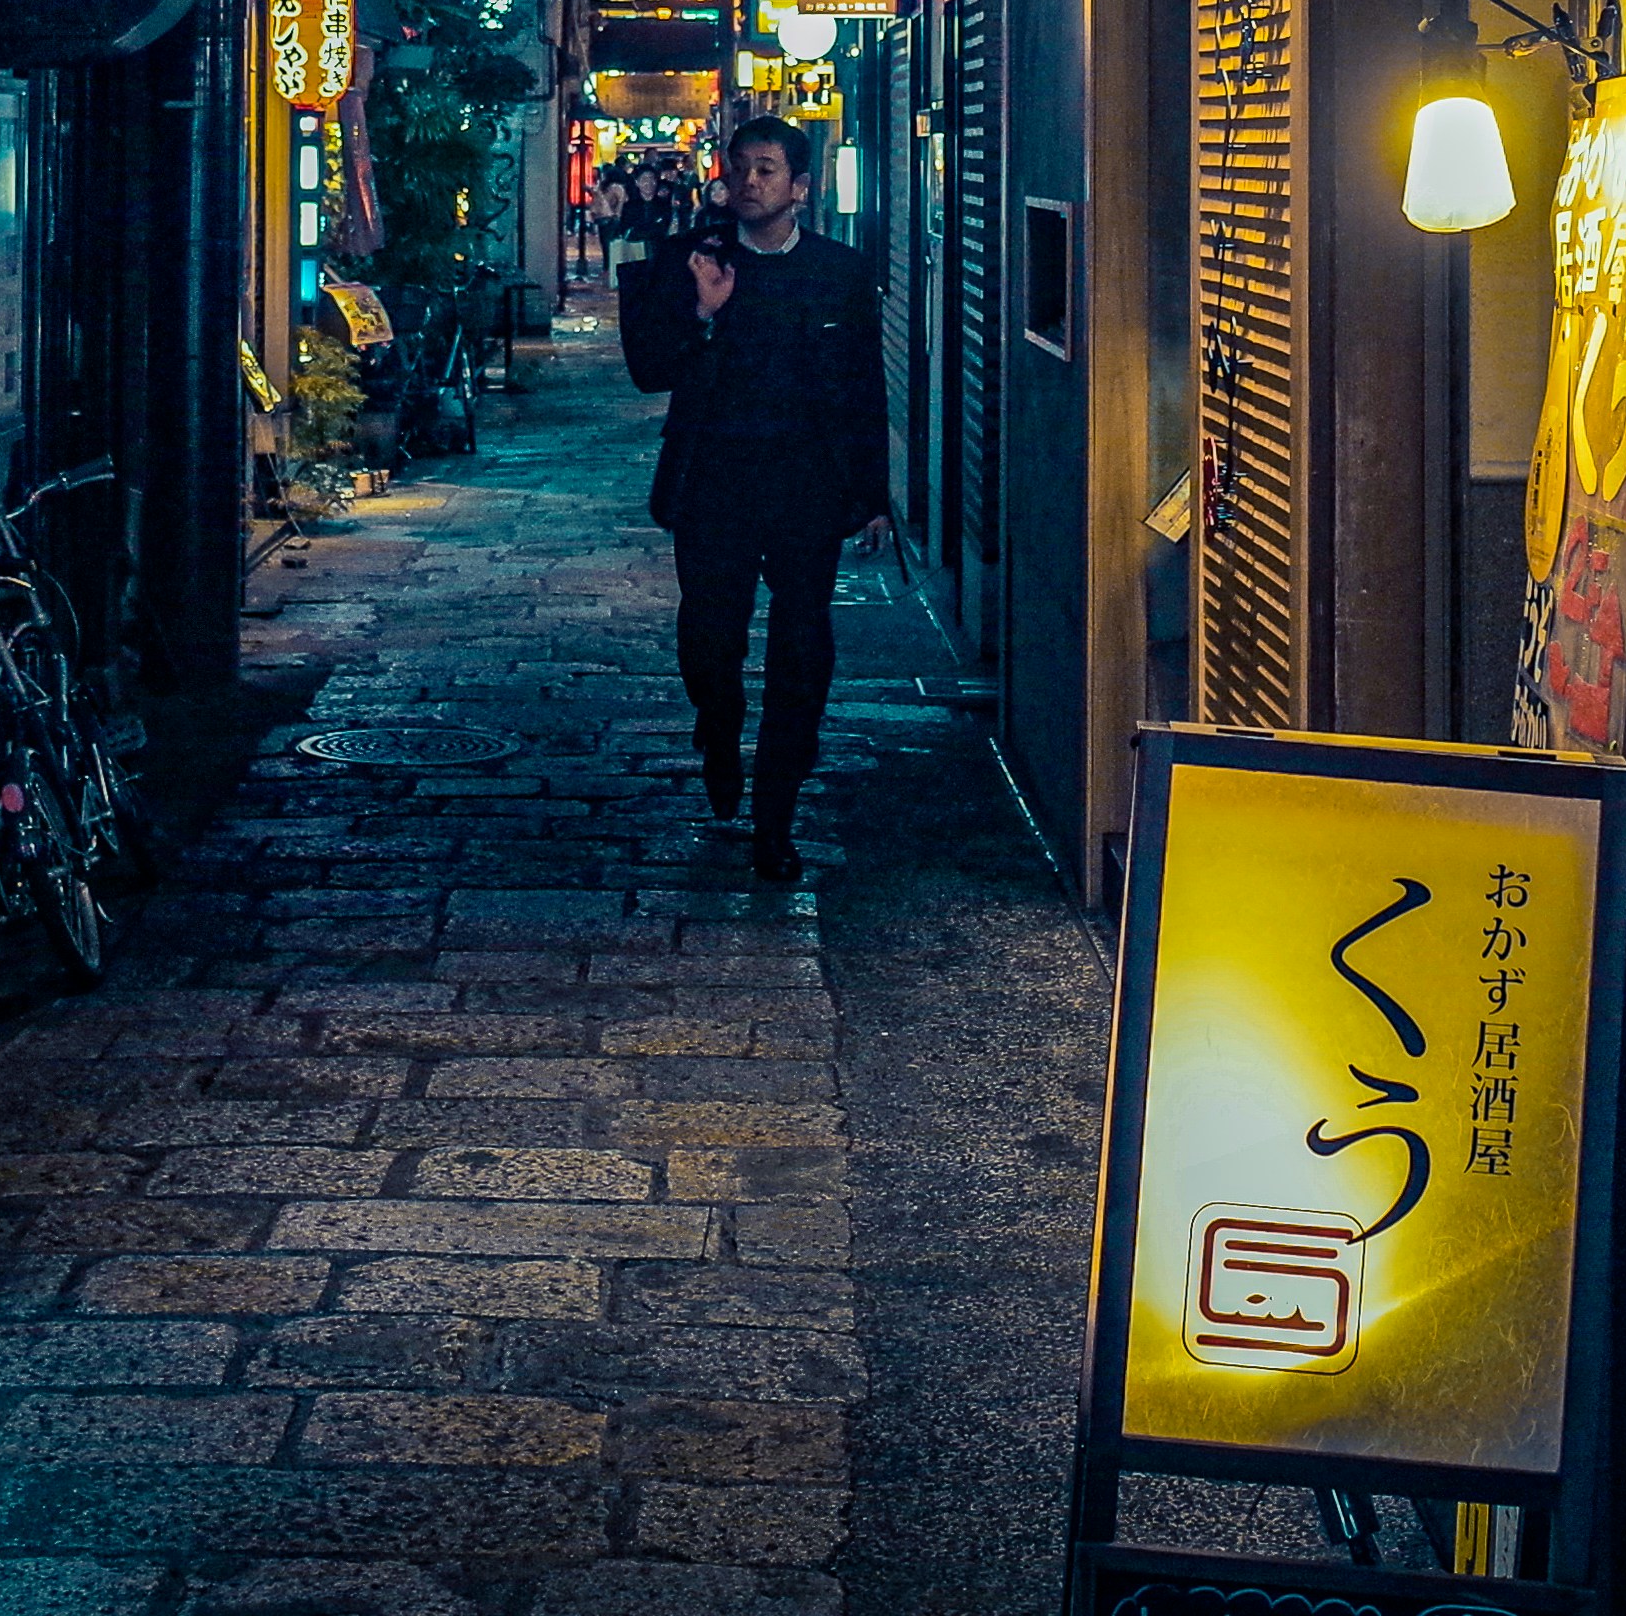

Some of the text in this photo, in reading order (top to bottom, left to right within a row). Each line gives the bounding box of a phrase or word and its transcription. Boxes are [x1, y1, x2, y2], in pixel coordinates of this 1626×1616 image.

[1305, 876, 1434, 1246] くう
[1463, 863, 1533, 1180] おかず居酒屋
